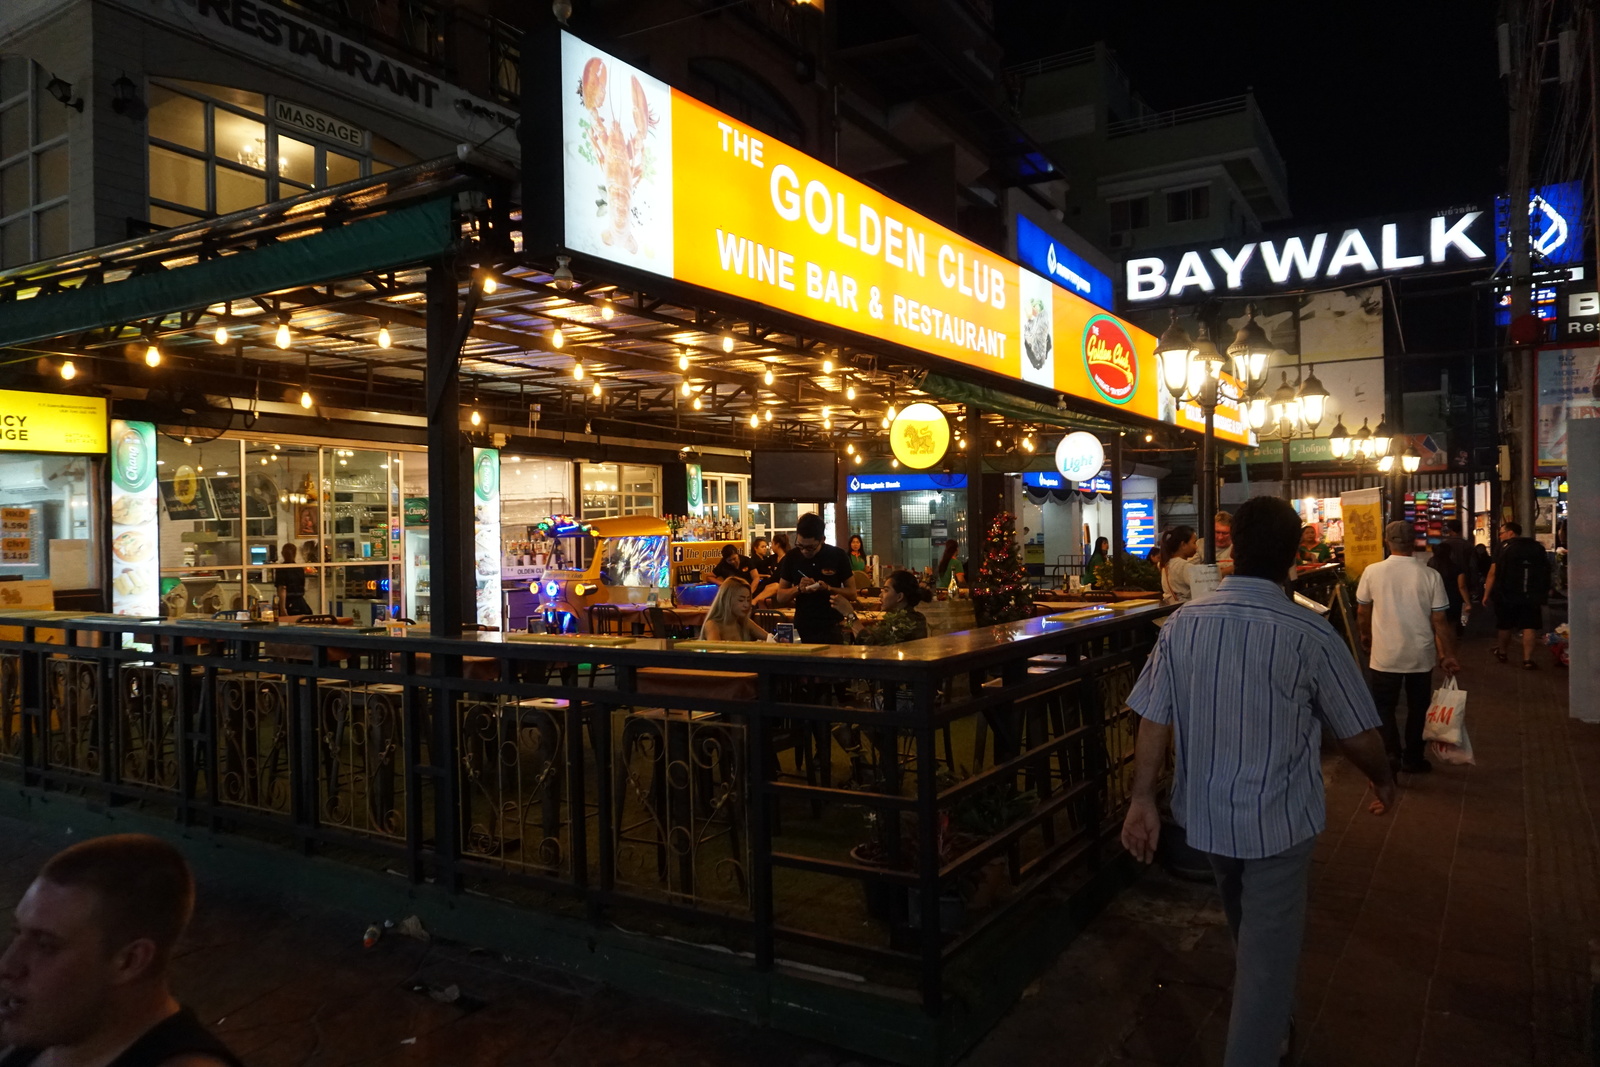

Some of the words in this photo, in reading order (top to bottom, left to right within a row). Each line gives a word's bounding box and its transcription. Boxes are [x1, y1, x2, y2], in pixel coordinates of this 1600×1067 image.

[279, 104, 359, 144] MASSAGE
[718, 121, 764, 168] THE
[770, 163, 925, 277] GOLDEN
[938, 244, 1006, 310] CLUB
[1126, 211, 1487, 301] BAYWALK
[716, 228, 795, 291] WINE
[806, 261, 858, 312] BAR
[868, 286, 883, 319] &
[893, 294, 1006, 359] RESTAURANT
[0, 415, 27, 427] CY
[0, 429, 28, 441] GE
[125, 446, 140, 480] Chang
[1063, 455, 1093, 472] Light
[409, 507, 427, 516] Chang
[686, 548, 700, 559] The
